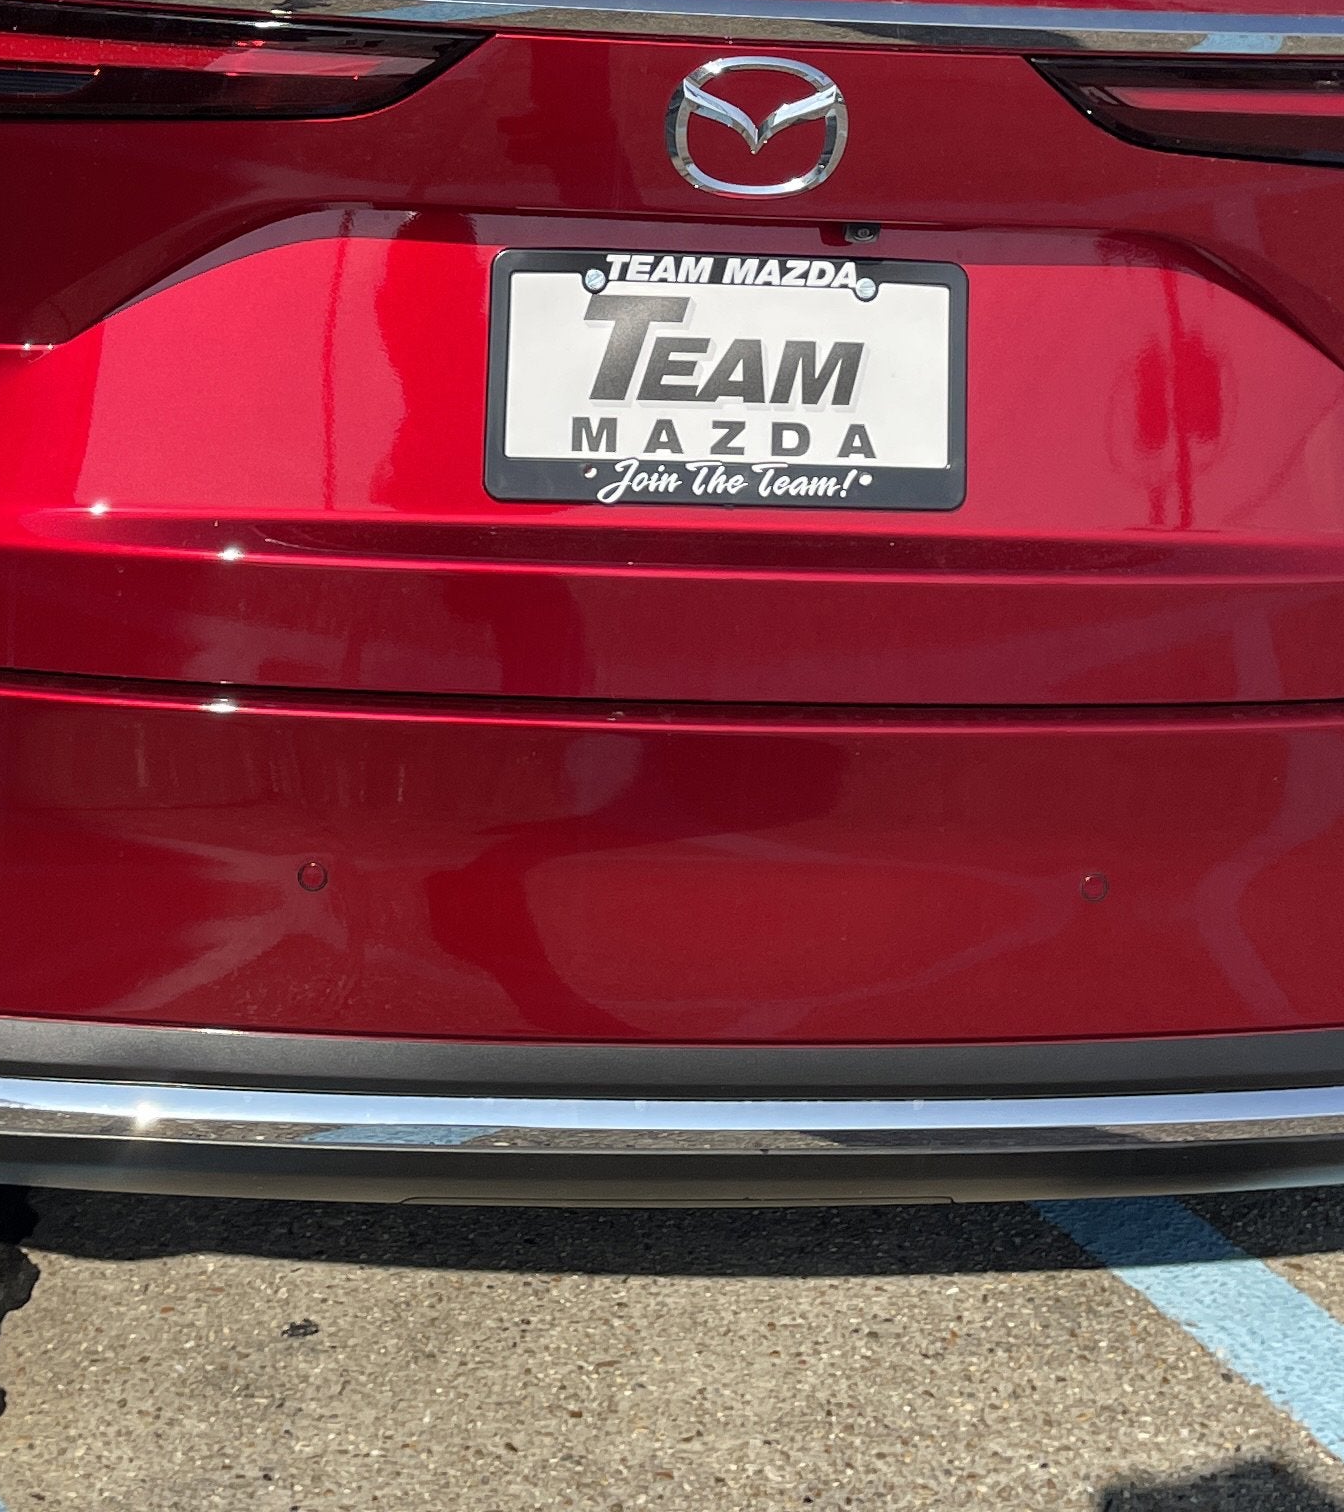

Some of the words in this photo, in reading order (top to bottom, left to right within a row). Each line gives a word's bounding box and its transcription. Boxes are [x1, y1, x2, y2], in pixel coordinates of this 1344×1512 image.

[606, 254, 713, 283] TEAM
[721, 258, 857, 288] MAZDA
[584, 294, 866, 406] TEAM
[571, 417, 877, 459] MAZDA
[597, 460, 683, 504] Join
[687, 462, 748, 498] The
[751, 464, 857, 498] Team!
